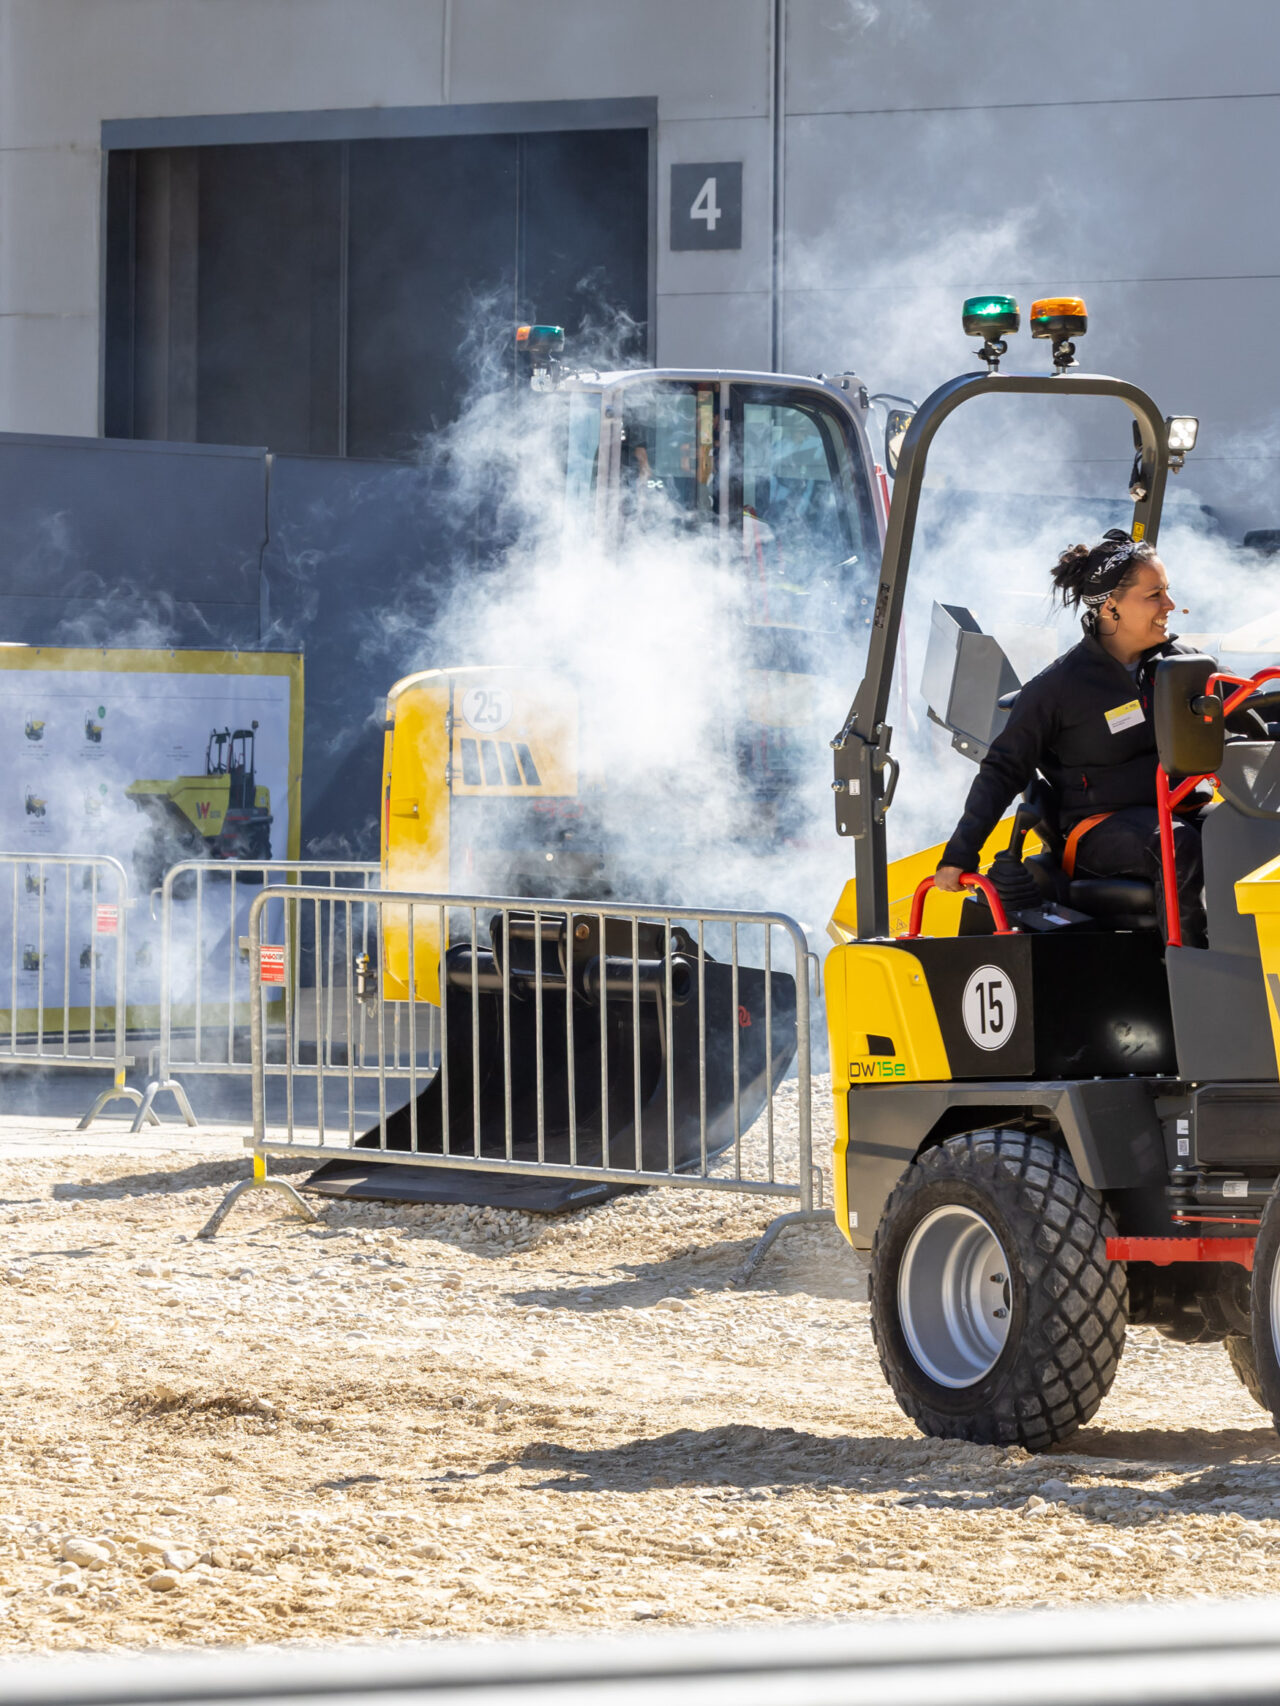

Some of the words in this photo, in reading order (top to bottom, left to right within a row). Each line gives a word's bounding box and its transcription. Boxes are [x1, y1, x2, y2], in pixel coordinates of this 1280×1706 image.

[690, 177, 721, 230] 4
[473, 690, 502, 723] 25
[975, 981, 1004, 1034] 15
[850, 1061, 906, 1077] DW15e
